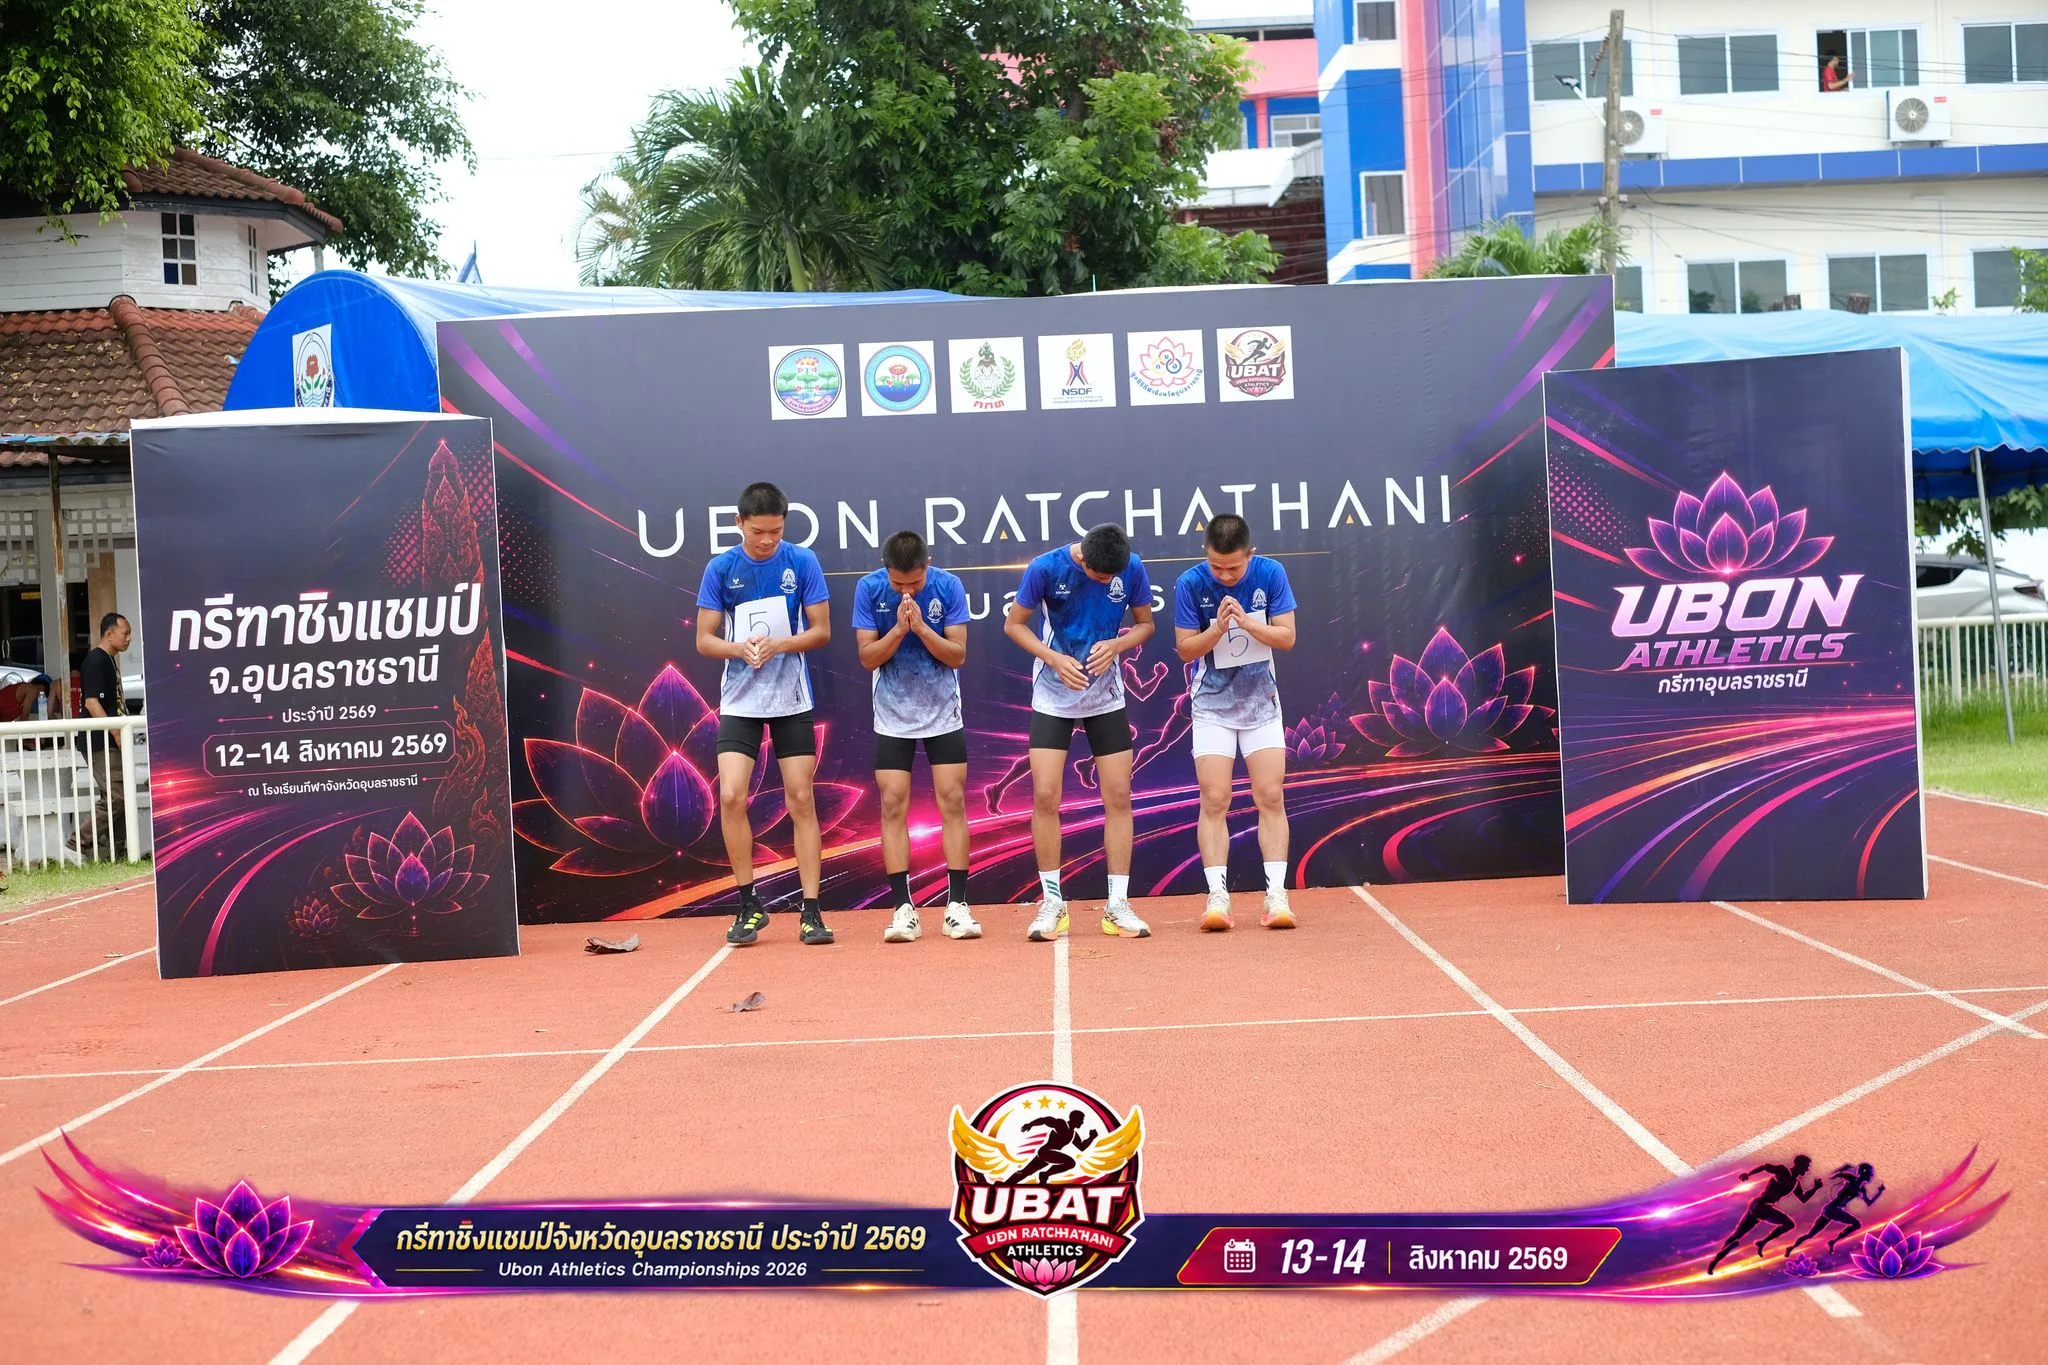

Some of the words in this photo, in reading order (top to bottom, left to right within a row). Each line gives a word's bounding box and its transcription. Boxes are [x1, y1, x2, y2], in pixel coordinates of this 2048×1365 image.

[1231, 364, 1281, 378] UBAT
[1062, 388, 1092, 396] NSDF
[925, 475, 1451, 546] RATCHATHANI
[169, 582, 482, 651] กรีฑาชิงแชมป์
[1611, 574, 1865, 638] UBON
[749, 611, 771, 637] 5
[1228, 626, 1249, 657] 5
[1616, 632, 1856, 671] ATHLETICS
[209, 644, 440, 703] จ.อุบลราชธานี
[1658, 668, 1808, 696] กรีฑาอุบลราชธานี
[282, 706, 334, 723] ประจำปี
[339, 704, 377, 720] 2569
[215, 741, 290, 767] 12-14
[299, 739, 383, 763] สิงหาคม
[391, 732, 448, 757] 2569
[248, 786, 260, 797] ณ
[263, 774, 418, 796] โรงเรียนกีฬาจังหวัดอุบลราชธานี
